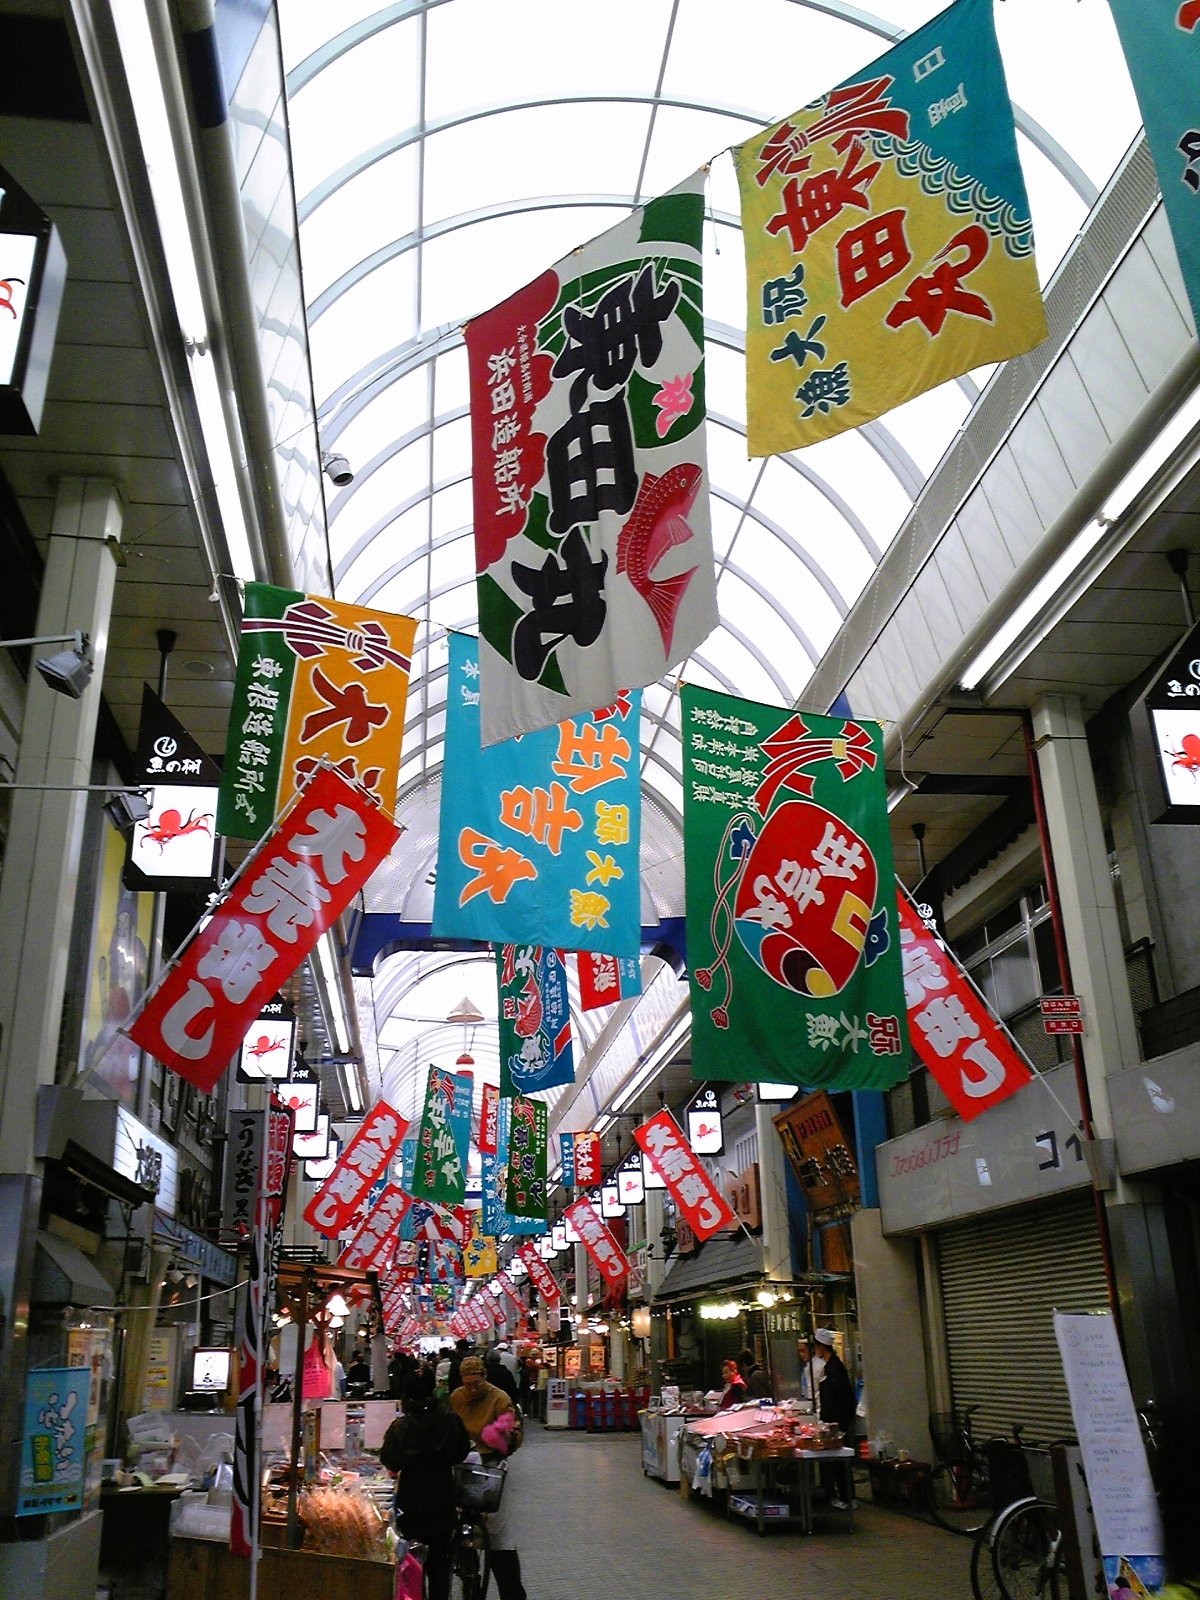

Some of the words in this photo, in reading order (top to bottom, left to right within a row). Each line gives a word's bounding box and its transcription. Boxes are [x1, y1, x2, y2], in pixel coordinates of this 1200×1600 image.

[654, 371, 694, 439] 祝
[761, 262, 852, 419] 祝大漁
[486, 345, 527, 516] 浜田造船所
[510, 262, 683, 682] 東田丸
[146, 756, 202, 775] 魚の棚
[160, 802, 367, 1060] 大売出し
[234, 1116, 259, 1194] うなぎ
[313, 1113, 398, 1227] 大売出し
